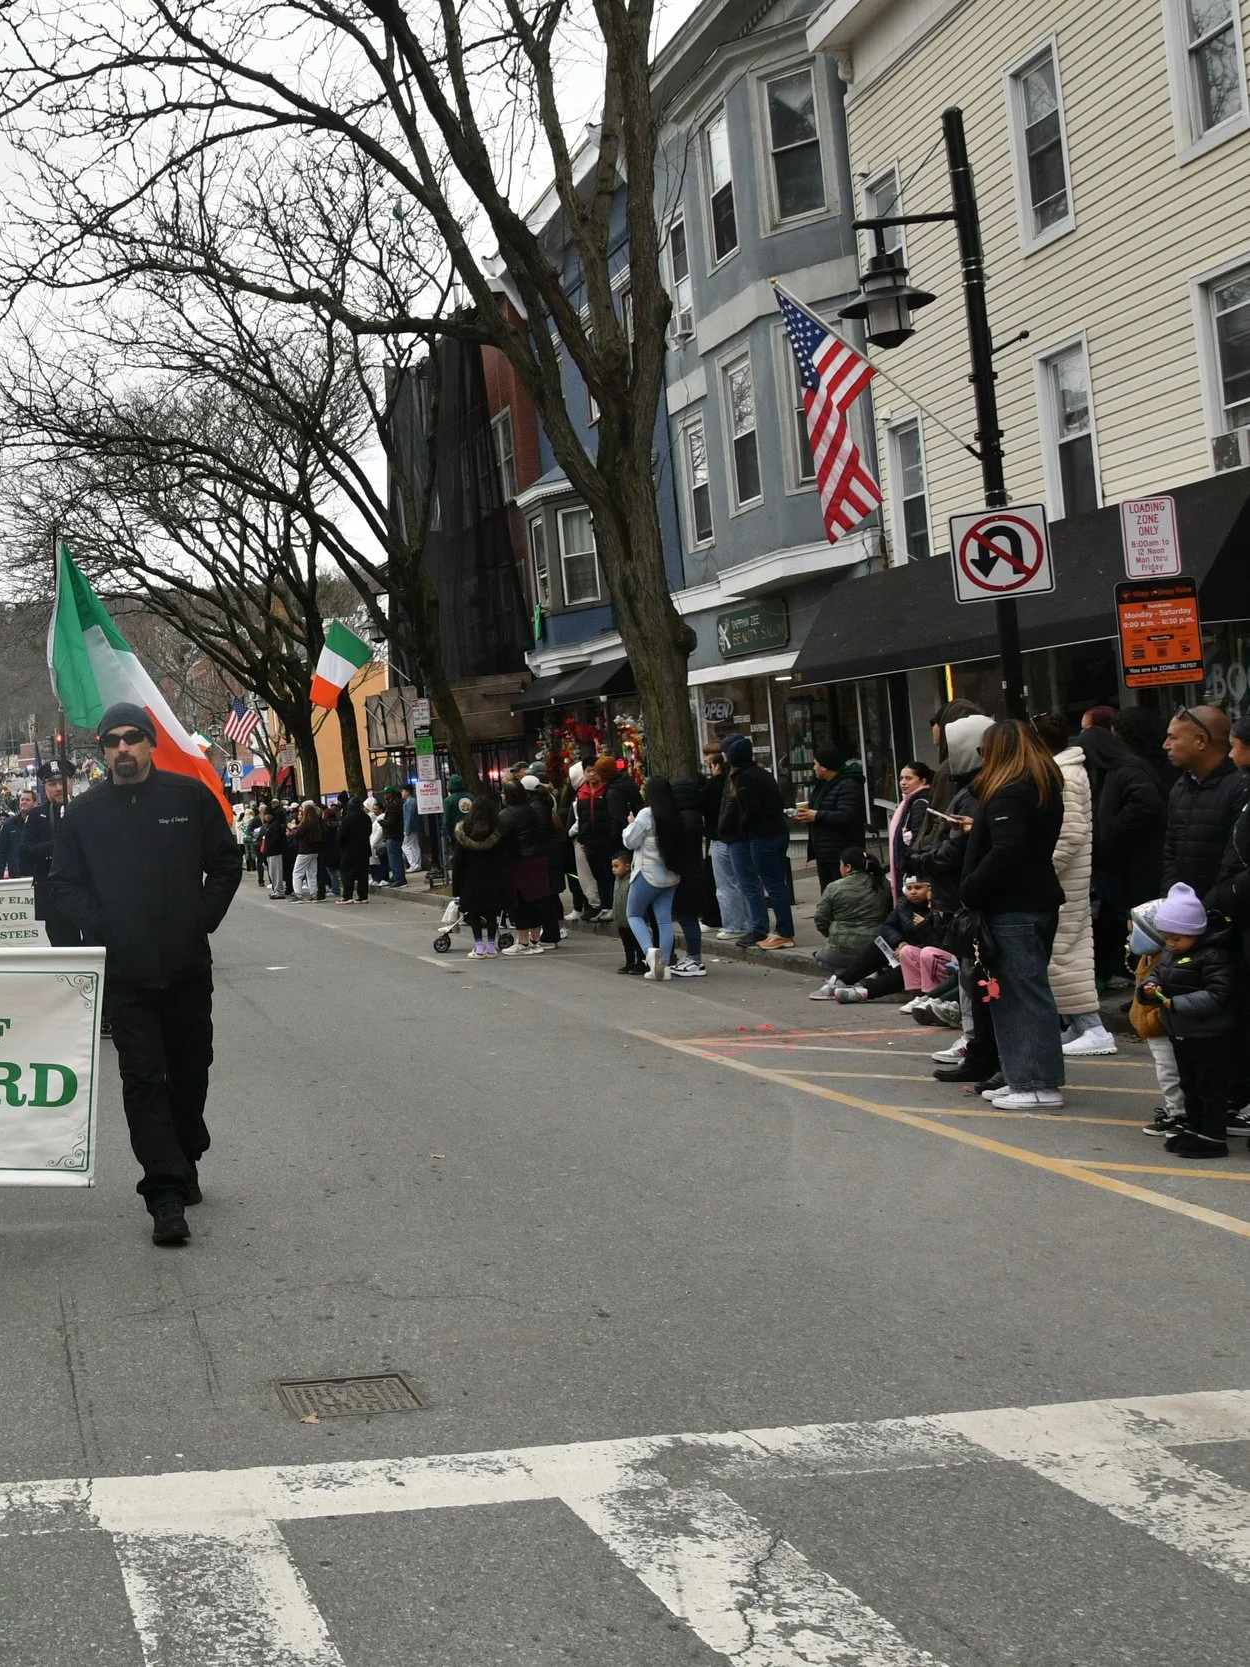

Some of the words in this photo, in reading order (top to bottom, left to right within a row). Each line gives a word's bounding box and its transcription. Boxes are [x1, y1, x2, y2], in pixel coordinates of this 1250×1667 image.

[1128, 502, 1165, 514] LOADING
[1136, 514, 1160, 525] ZONE
[1138, 525, 1159, 536] ONLY
[1131, 540, 1159, 549] 8:00am
[1136, 556, 1150, 564] Mon
[1141, 563, 1164, 572] Friday
[1124, 610, 1154, 620] Monday
[1159, 607, 1192, 616] Saturday
[1122, 620, 1139, 629] 9:00
[1178, 616, 1195, 624] p.m.
[732, 628, 758, 646] BEAUTY
[1129, 666, 1140, 674] You
[1210, 663, 1250, 704] BO
[703, 702, 730, 719] OPEN
[8, 897, 35, 905] ELM
